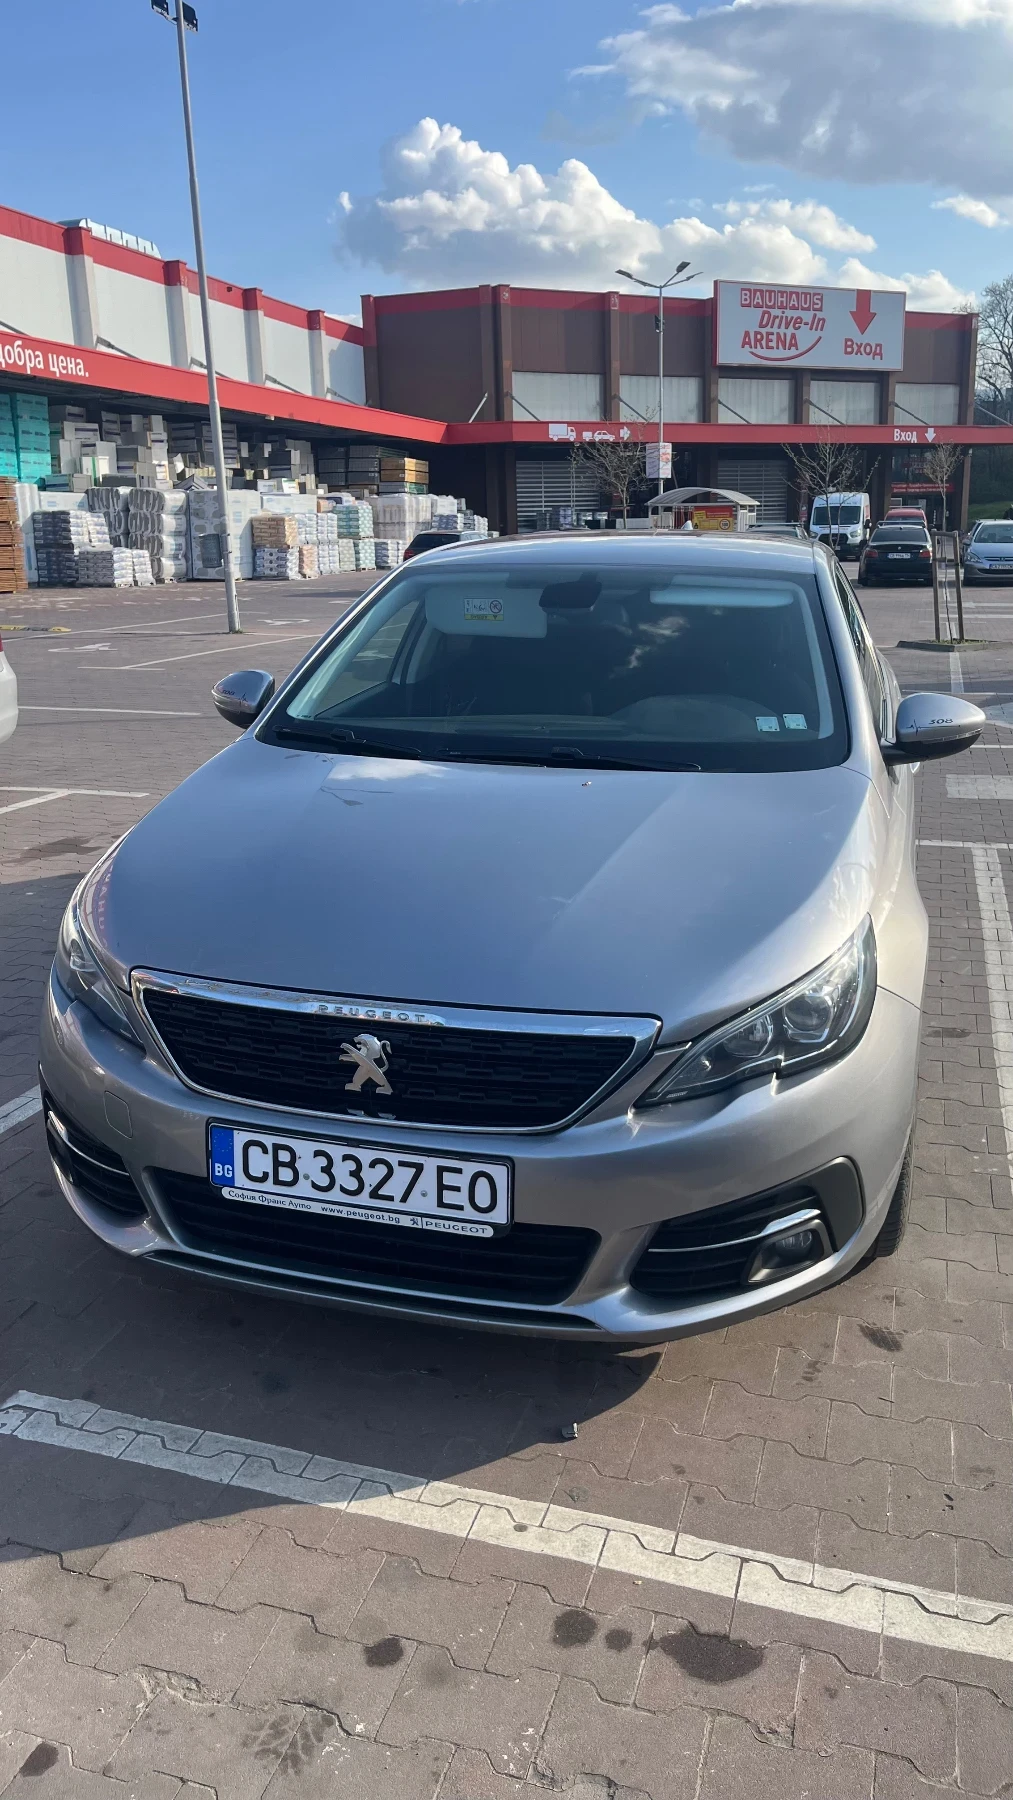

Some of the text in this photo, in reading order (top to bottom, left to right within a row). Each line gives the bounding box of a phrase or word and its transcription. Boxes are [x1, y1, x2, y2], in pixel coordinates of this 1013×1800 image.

[741, 289, 823, 310] BAUHAUS
[758, 310, 826, 332] Drive-In
[741, 330, 799, 350] ARENA
[844, 338, 883, 360] Вход
[48, 353, 89, 377] цена.
[894, 429, 917, 443] Вход
[318, 1004, 425, 1023] PEUGEOT
[214, 1163, 233, 1178] BG
[242, 1139, 300, 1187] CB
[311, 1149, 424, 1203] 3327
[321, 1205, 488, 1234] www.peugeot.bg PEUGEOT
